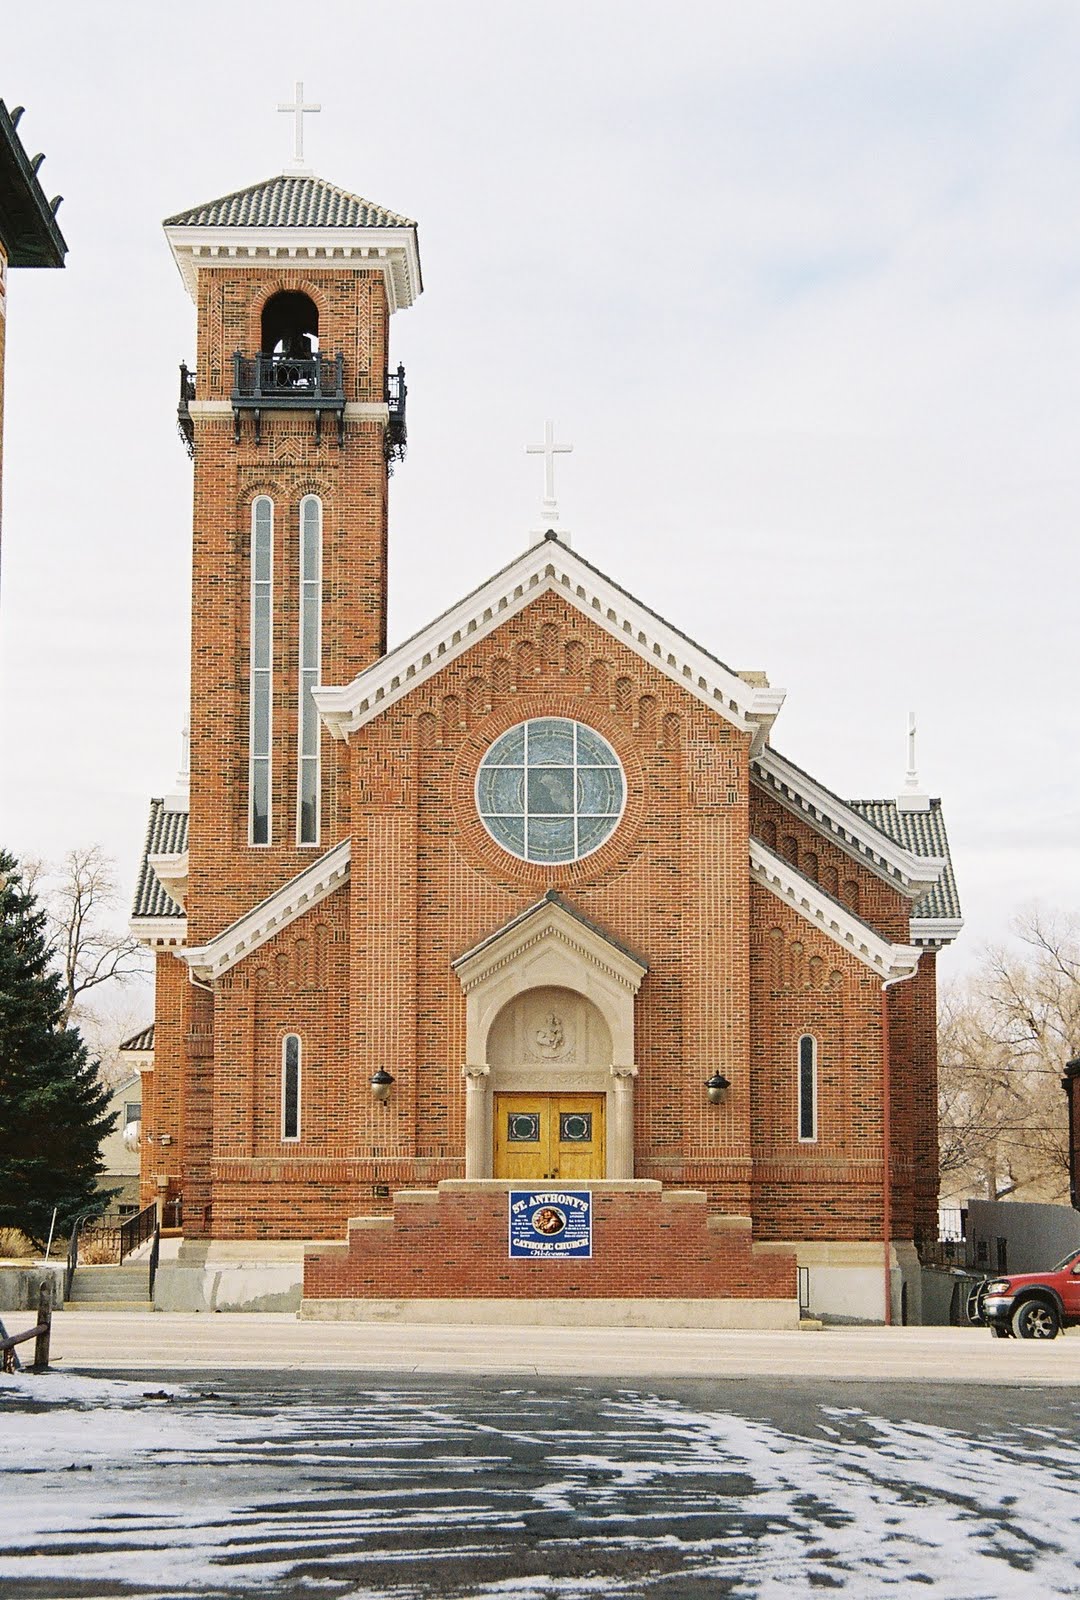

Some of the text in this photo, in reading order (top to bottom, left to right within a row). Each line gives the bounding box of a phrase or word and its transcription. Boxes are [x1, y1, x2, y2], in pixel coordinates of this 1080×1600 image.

[529, 1194, 588, 1212] ANTHONY'S
[513, 1238, 589, 1250] CATHOLIC CHURCH
